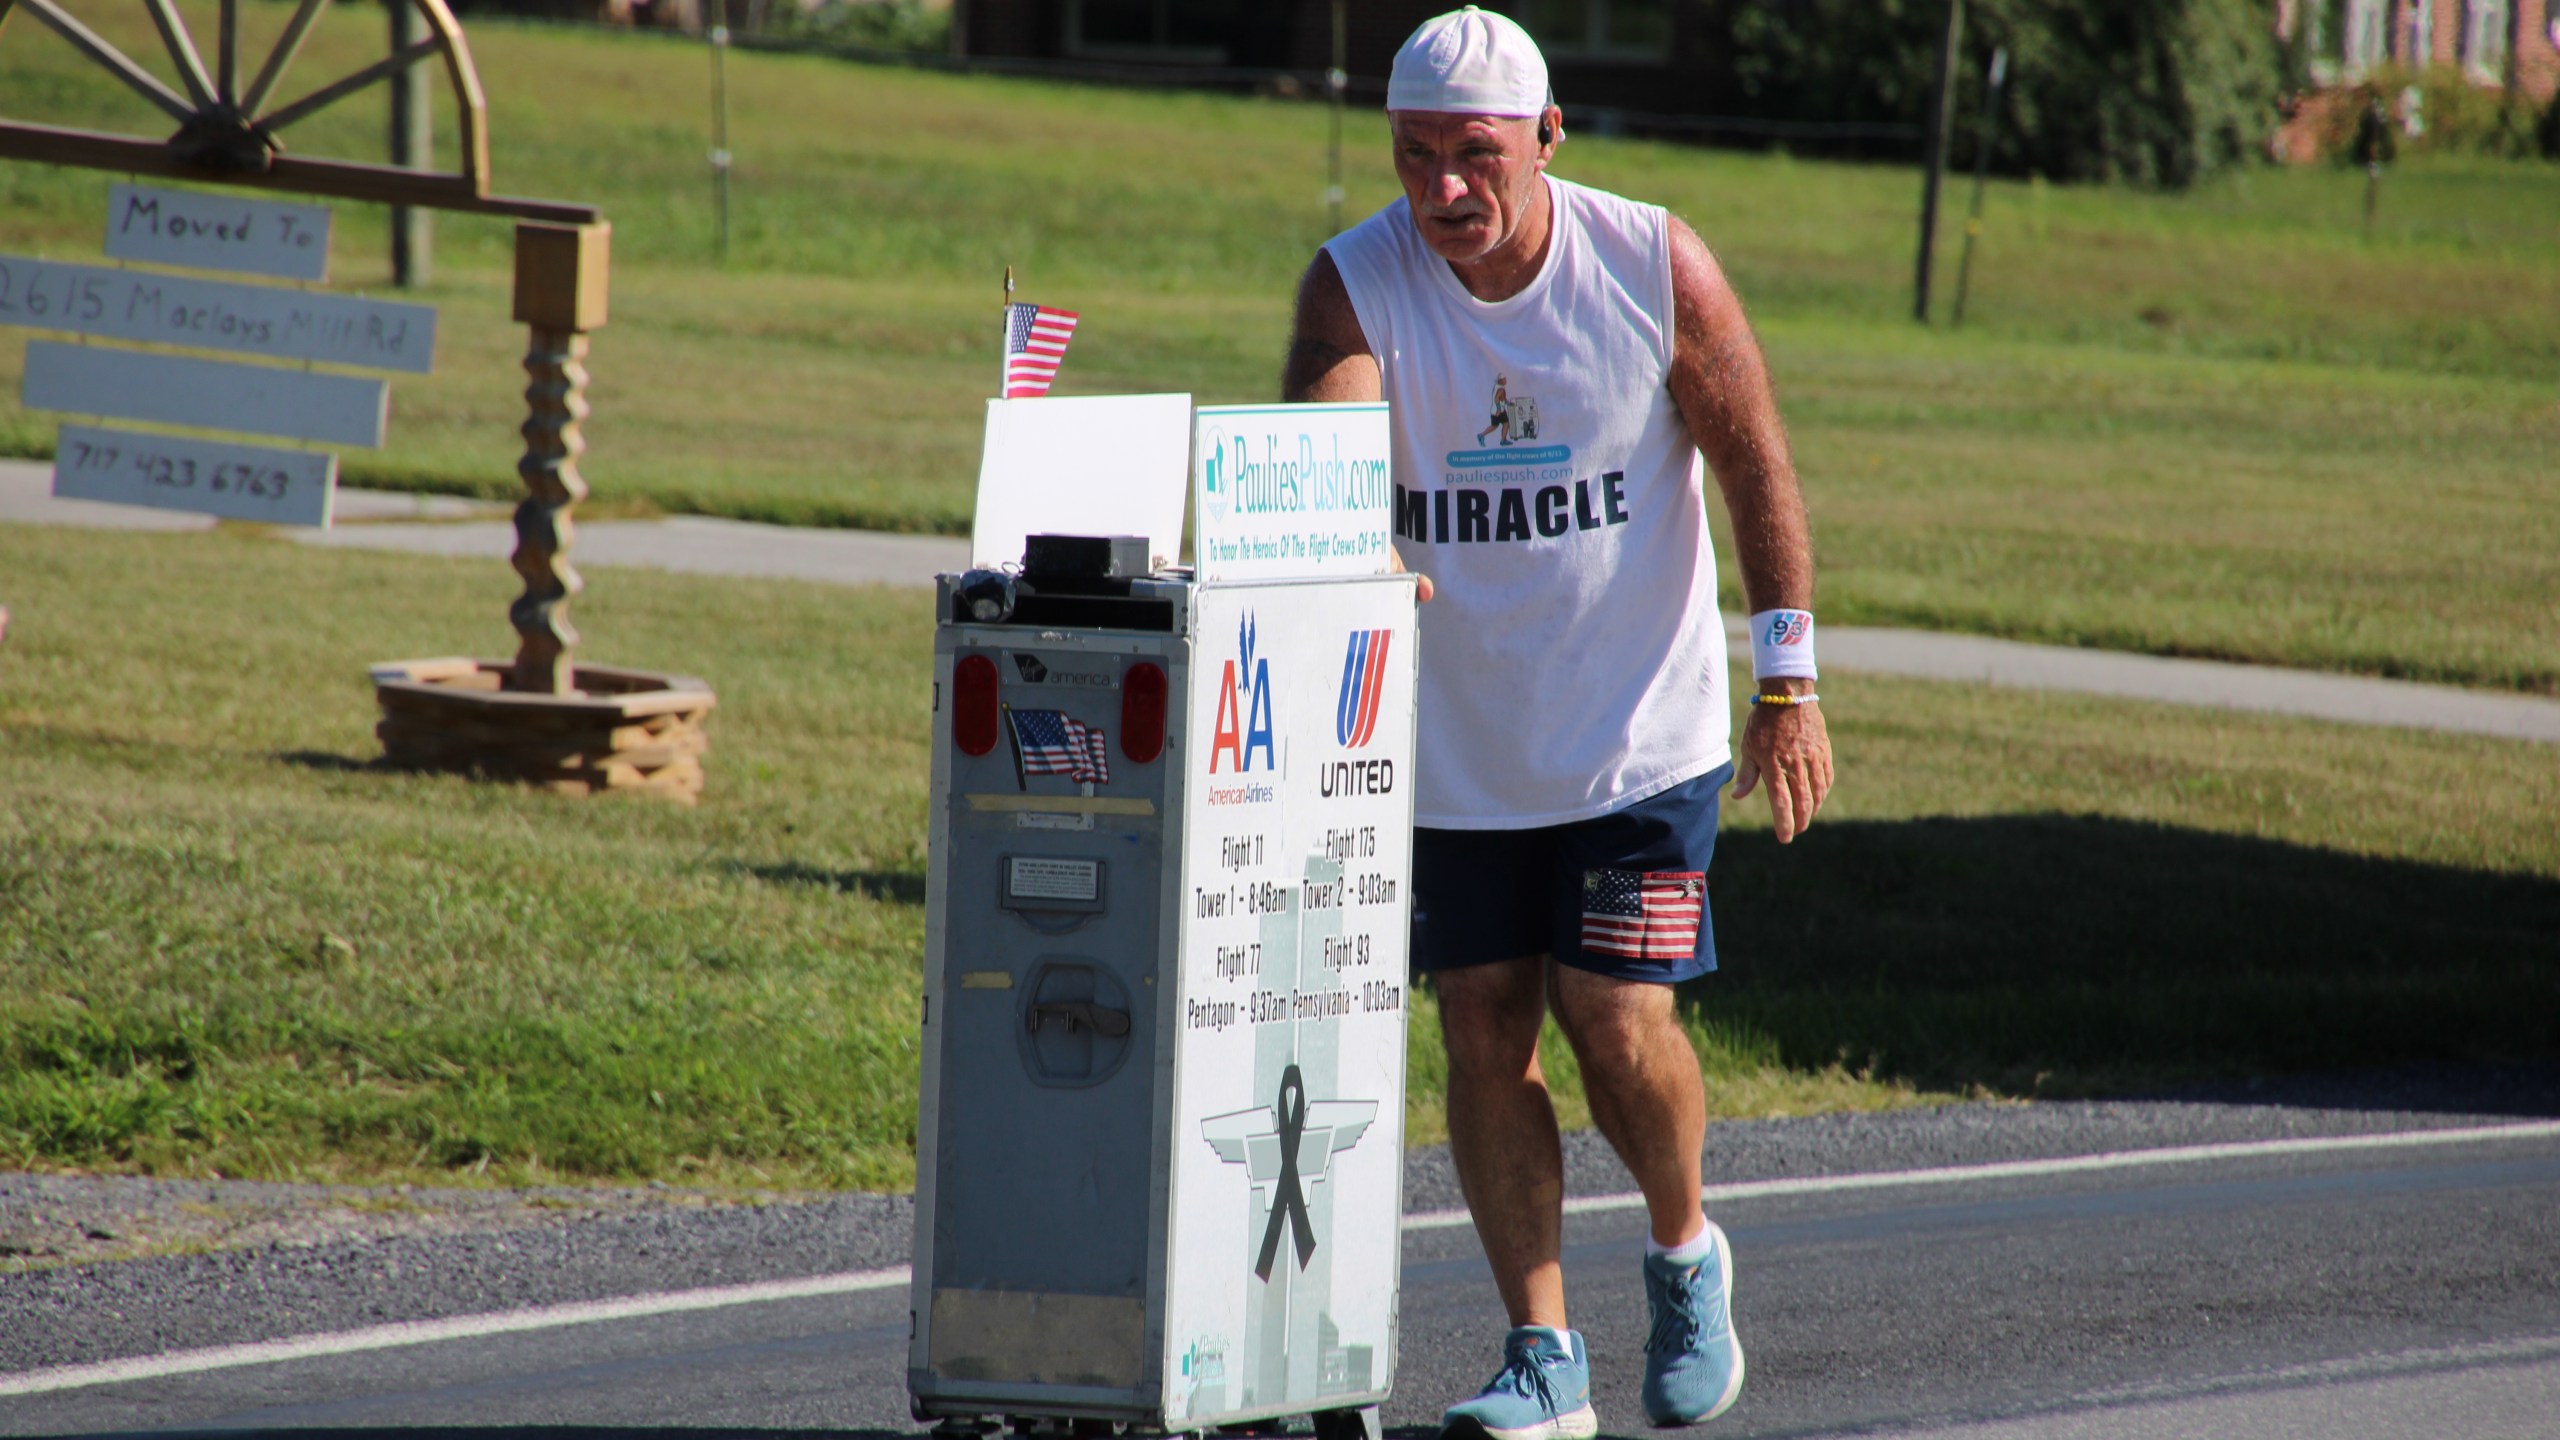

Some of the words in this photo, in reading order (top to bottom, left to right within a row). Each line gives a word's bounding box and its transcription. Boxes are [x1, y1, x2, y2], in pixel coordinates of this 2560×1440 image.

[122, 194, 251, 242] Moved
[277, 214, 313, 249] To
[0, 262, 104, 322] 2615
[366, 314, 406, 354] Rd
[72, 441, 119, 472] 717
[134, 452, 197, 488] 423
[210, 461, 290, 499] 6763
[1234, 433, 1389, 514] PauliesPush.com
[1446, 467, 1573, 486] pauliespush.com
[1395, 471, 1629, 544] MIRACLE
[1210, 537, 1217, 562] To
[1219, 536, 1238, 561] Honor
[1240, 535, 1250, 560] The
[1253, 533, 1277, 559] Heroics
[1281, 534, 1289, 558] Of
[1292, 533, 1305, 558] The
[1309, 532, 1329, 563] Flight
[1333, 533, 1355, 556] Crews
[1358, 532, 1368, 555] Of
[1371, 532, 1387, 554] 9-11
[1773, 620, 1803, 636] 93
[1050, 672, 1111, 686] america
[1321, 759, 1394, 798] UNITED
[1222, 834, 1250, 873] Flight
[1255, 834, 1264, 865] 11
[1326, 827, 1354, 865] Flight
[1359, 826, 1375, 858] 175
[1196, 887, 1226, 919] Tower
[1230, 884, 1235, 916] 1
[1249, 881, 1287, 915] 8:46am
[1303, 878, 1333, 912] Tower
[1337, 876, 1343, 907] 2
[1359, 873, 1396, 906] 9:03am
[1216, 945, 1245, 983] Flight
[1250, 943, 1261, 975] 77
[1324, 936, 1352, 973] Flight
[1357, 934, 1370, 966] 93
[1188, 996, 1235, 1032] Pentagon
[1250, 991, 1287, 1024] 9:37am
[1292, 985, 1350, 1022] Pennsylvania
[1363, 980, 1399, 1013] 10:03am
